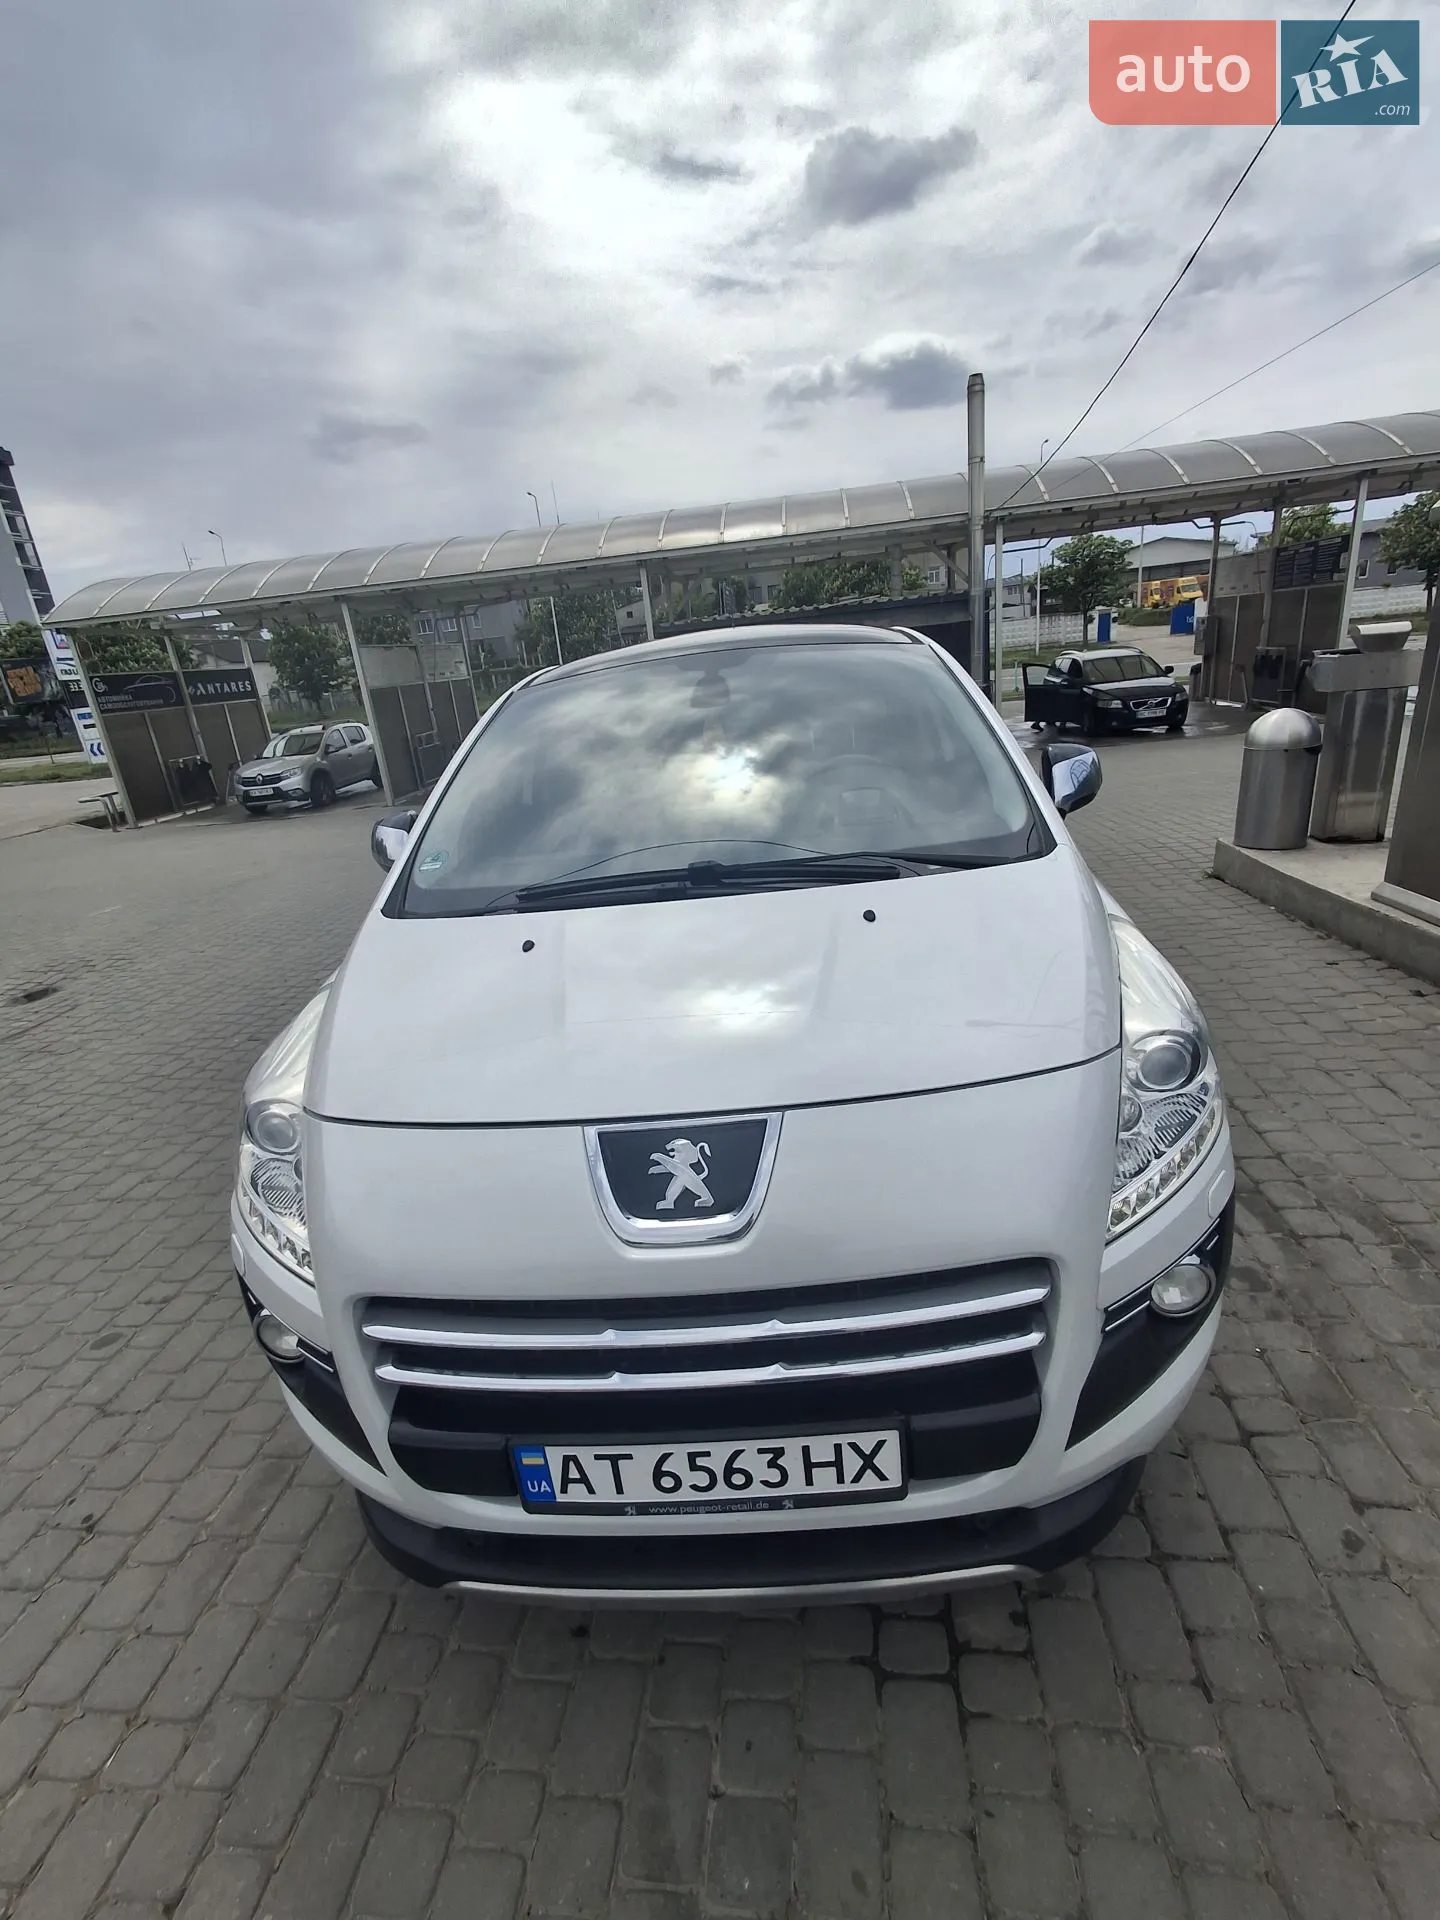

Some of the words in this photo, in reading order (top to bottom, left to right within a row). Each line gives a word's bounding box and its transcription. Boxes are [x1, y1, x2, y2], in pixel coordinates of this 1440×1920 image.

[196, 680, 252, 696] ANTARES
[527, 1479, 551, 1494] UA
[559, 1453, 634, 1495] AT
[652, 1446, 789, 1494] 6563
[802, 1439, 890, 1487] HX
[648, 1500, 769, 1514] www.peugeot-retail.de
